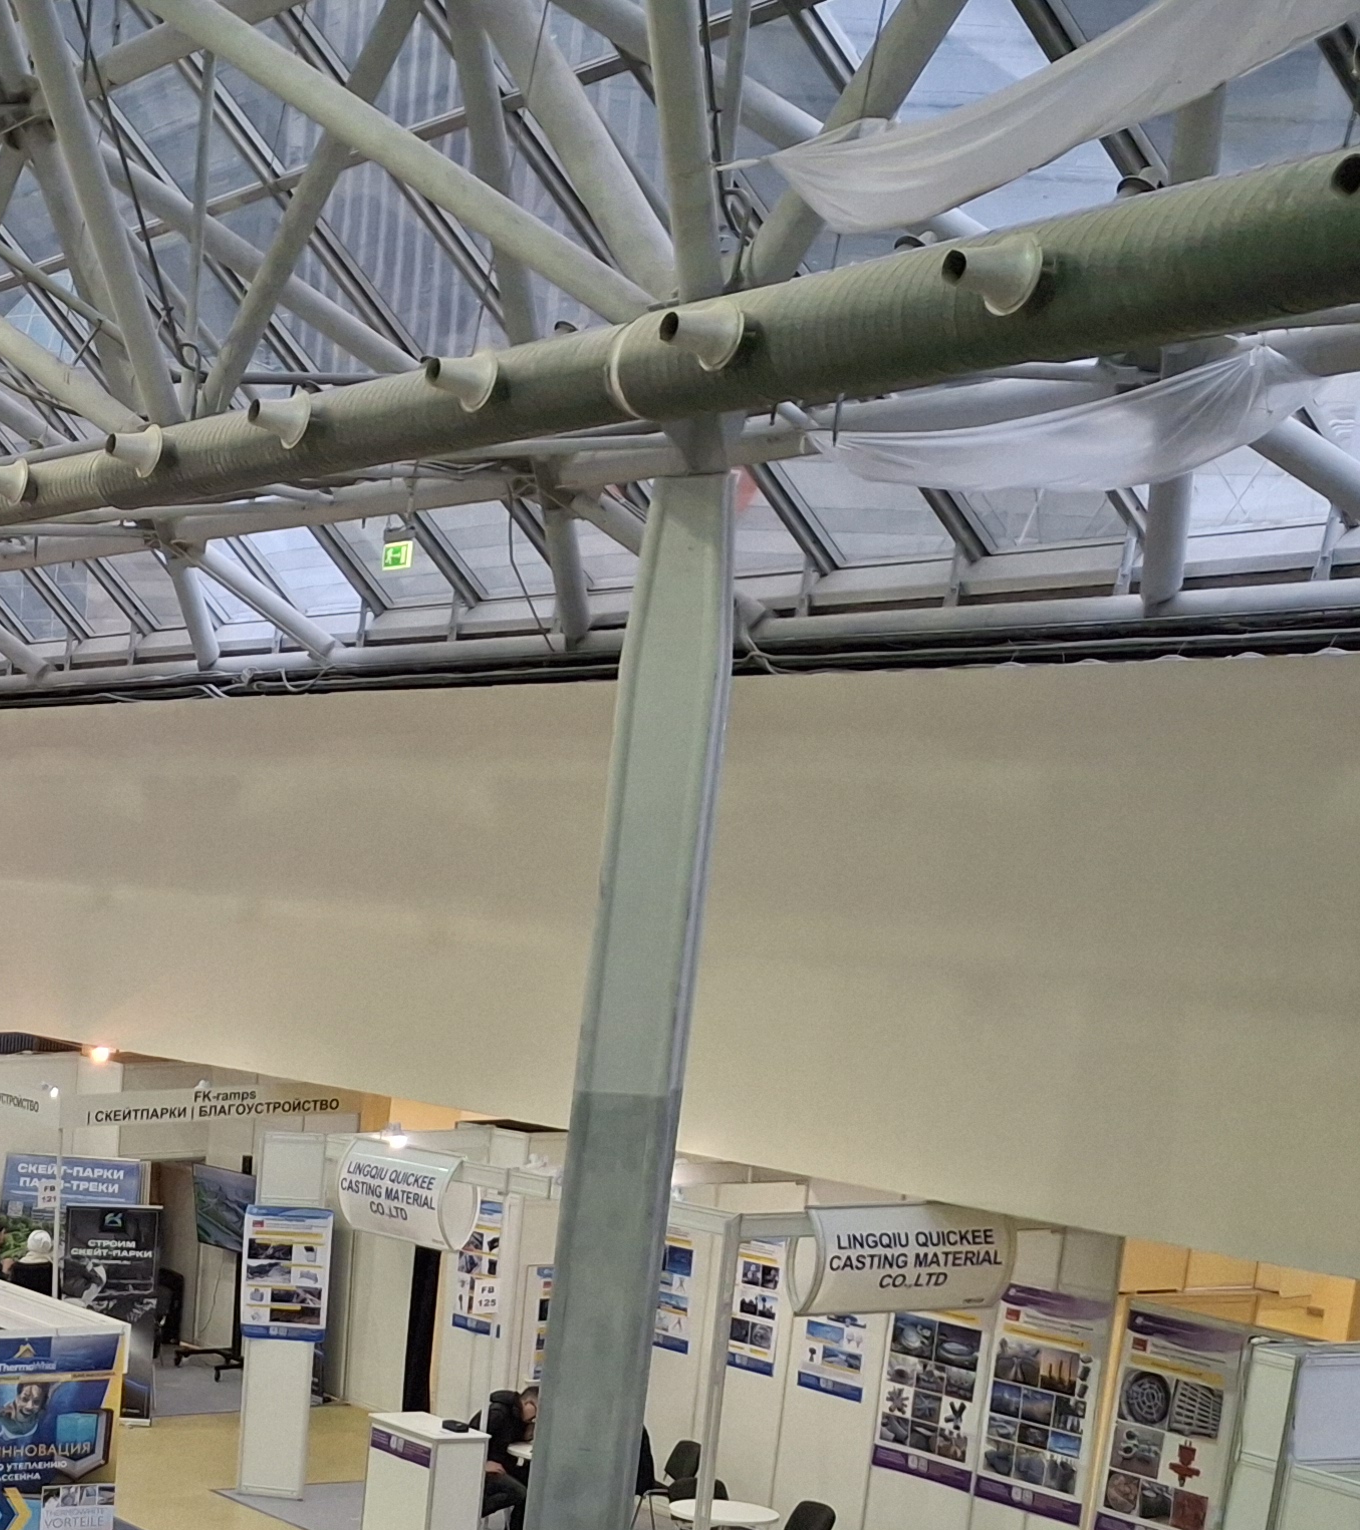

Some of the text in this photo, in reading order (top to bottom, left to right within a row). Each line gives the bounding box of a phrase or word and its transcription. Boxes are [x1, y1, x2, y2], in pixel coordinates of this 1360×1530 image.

[194, 1090, 257, 1103] FK-ramps
[94, 1098, 340, 1122] СКЕЙТПАРКИ БЛАГОУСТРОЙСТВО
[347, 1161, 436, 1190] LINGQIU QUICKEE
[340, 1177, 436, 1211] CASTING MATERIAL
[88, 1240, 136, 1248] СТРОИМ
[836, 1229, 995, 1250] LINGQIU QUICKEE
[830, 1248, 1003, 1272] CASTING MATERIAL
[6, 1460, 68, 1473] УТЕПЛЕНИЮ
[44, 1516, 104, 1528] VORTEILE
